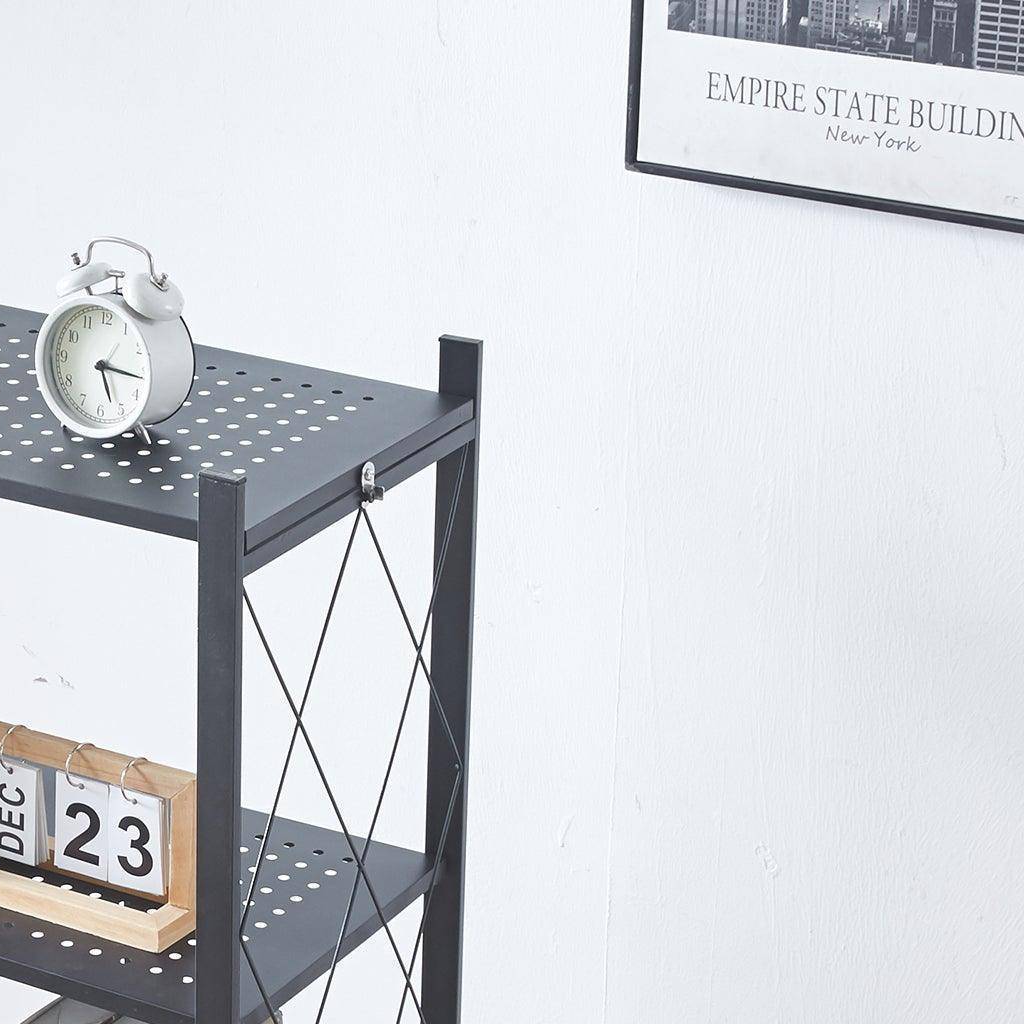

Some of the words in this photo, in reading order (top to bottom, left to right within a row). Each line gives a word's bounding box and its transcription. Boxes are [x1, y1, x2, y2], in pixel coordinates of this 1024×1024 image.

[706, 71, 806, 113] EMPIRE
[814, 86, 900, 126] STATE
[825, 125, 870, 146] New
[874, 131, 922, 152] York
[83, 315, 92, 329] 11
[101, 311, 113, 325] 12
[68, 329, 79, 344] 10
[60, 350, 68, 363] 9
[65, 373, 73, 387] 8
[80, 393, 87, 406] 7
[96, 404, 105, 418] 6
[117, 402, 125, 416] 5
